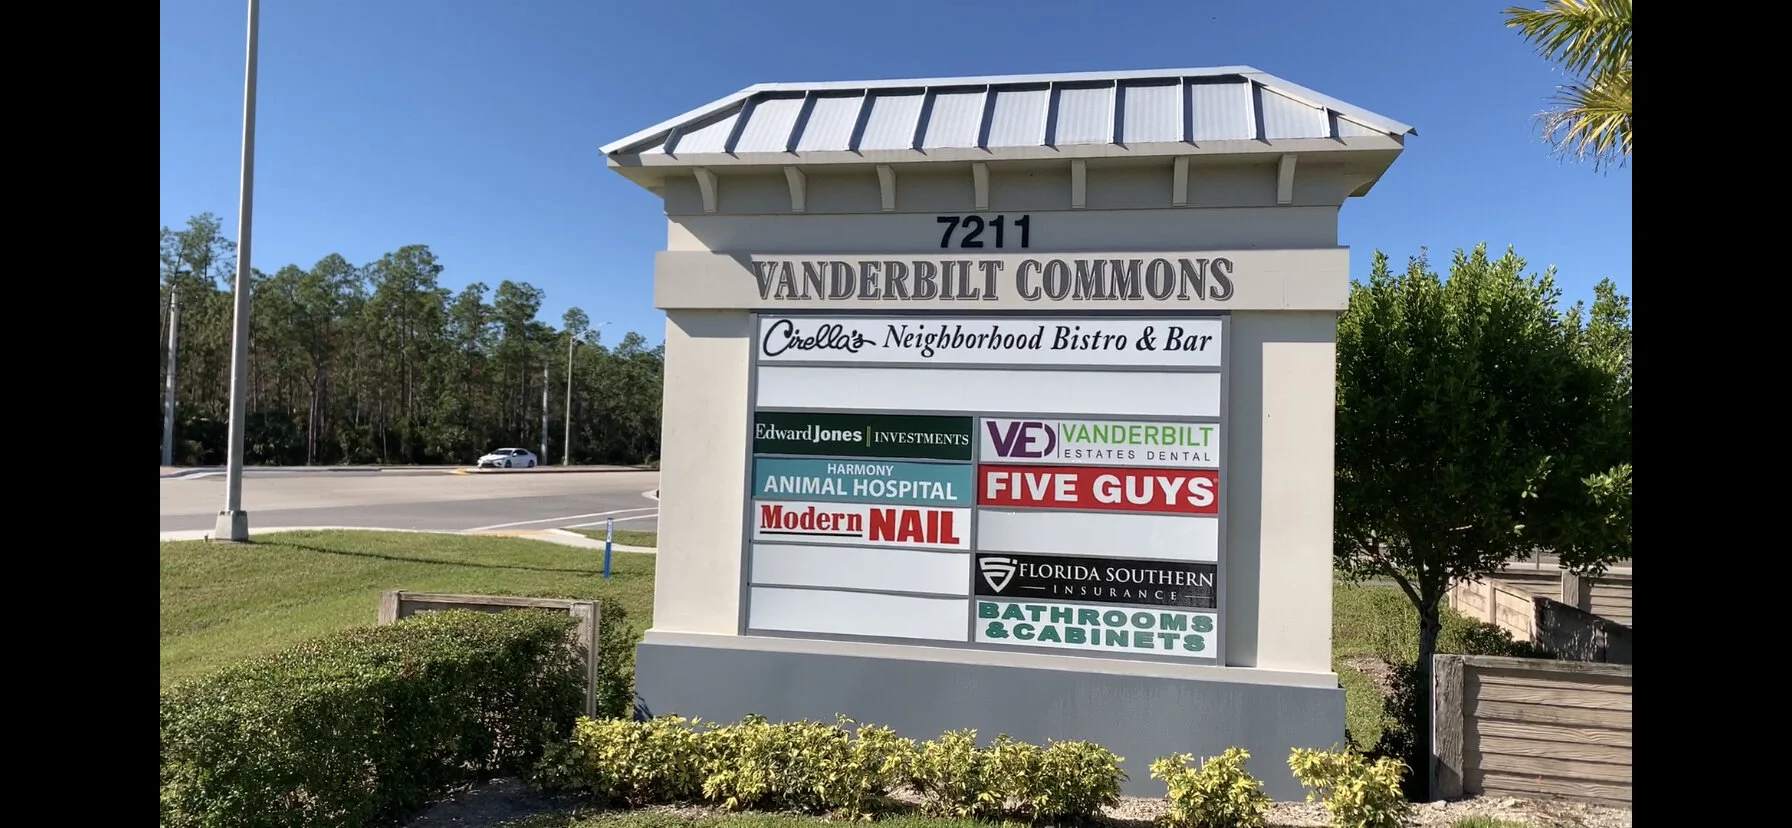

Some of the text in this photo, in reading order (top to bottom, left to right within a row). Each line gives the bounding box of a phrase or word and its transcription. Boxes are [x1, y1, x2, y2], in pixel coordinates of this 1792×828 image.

[937, 215, 1030, 248] 7211
[752, 258, 1234, 301] VANDERBILT COMMONS
[763, 319, 1212, 358] Cirella's Neighborhood Bistro & Bar
[875, 431, 969, 446] INVESTMENTS
[1062, 423, 1213, 447] VANDERBILT
[1065, 449, 1211, 462] ESTATES DENTAL
[827, 463, 894, 476] HARMONY
[764, 475, 957, 500] ANIMAL HOSPITAL
[987, 472, 1214, 507] FIVE GUYS
[760, 505, 959, 544] Modern NAIL
[1019, 563, 1214, 587] FLORIDA SOUTHERN
[1053, 584, 1177, 600] INSURANCE
[978, 602, 1213, 633] BATHROOMS
